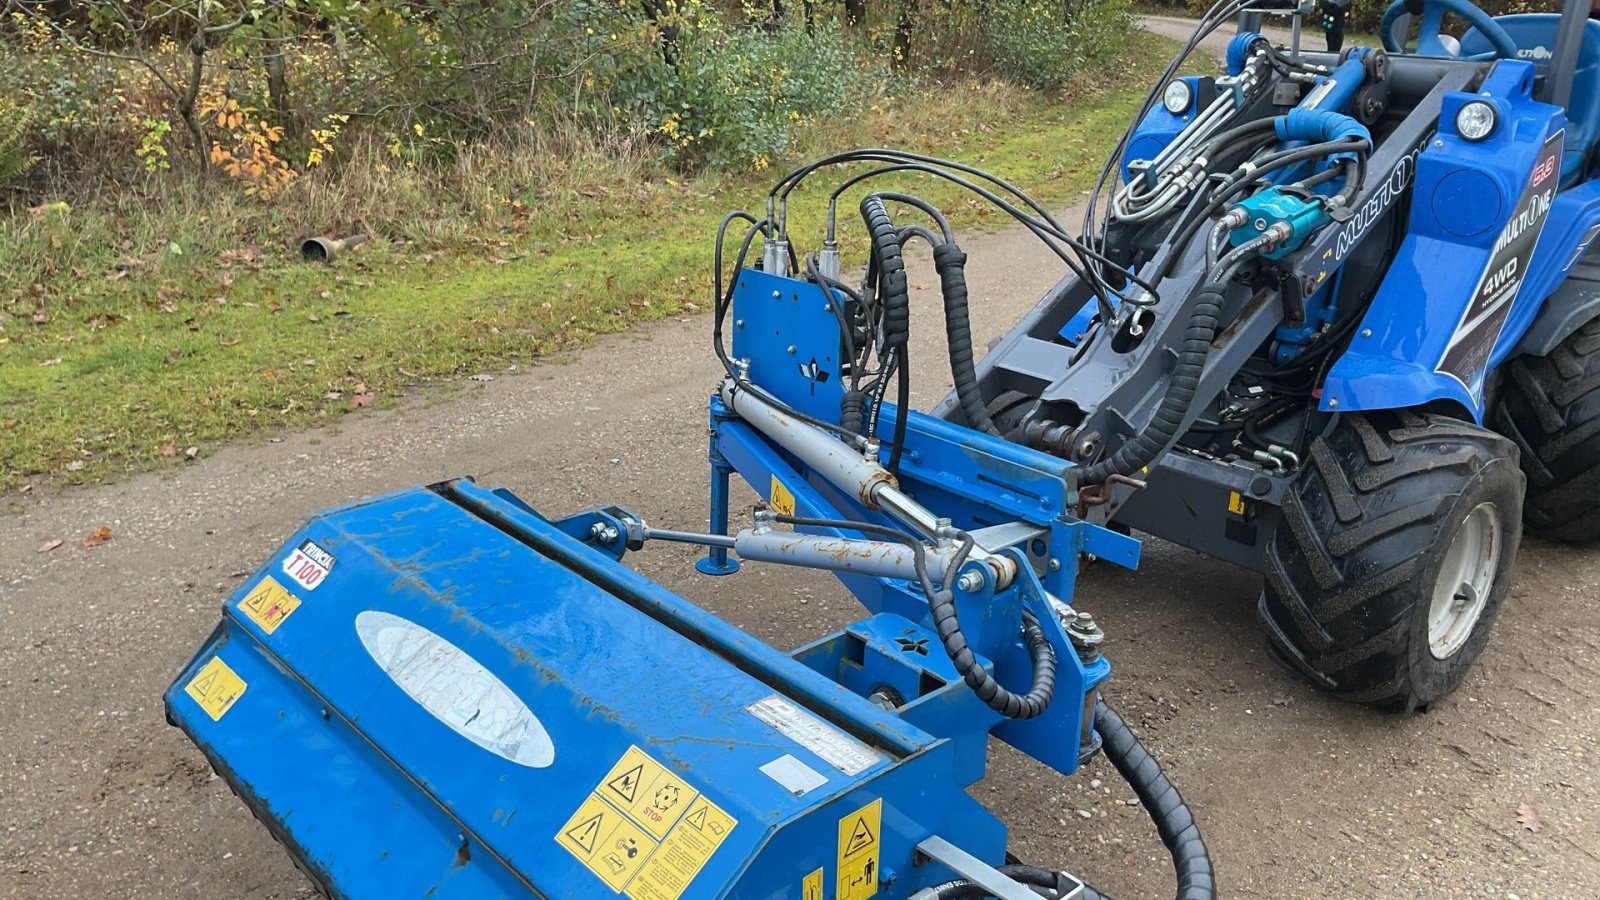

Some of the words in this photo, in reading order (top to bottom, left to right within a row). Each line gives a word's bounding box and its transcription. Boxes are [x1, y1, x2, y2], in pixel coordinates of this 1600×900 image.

[1483, 257, 1518, 295] 4WD
[302, 541, 335, 569] TRINCIA
[643, 806, 663, 823] STOP
